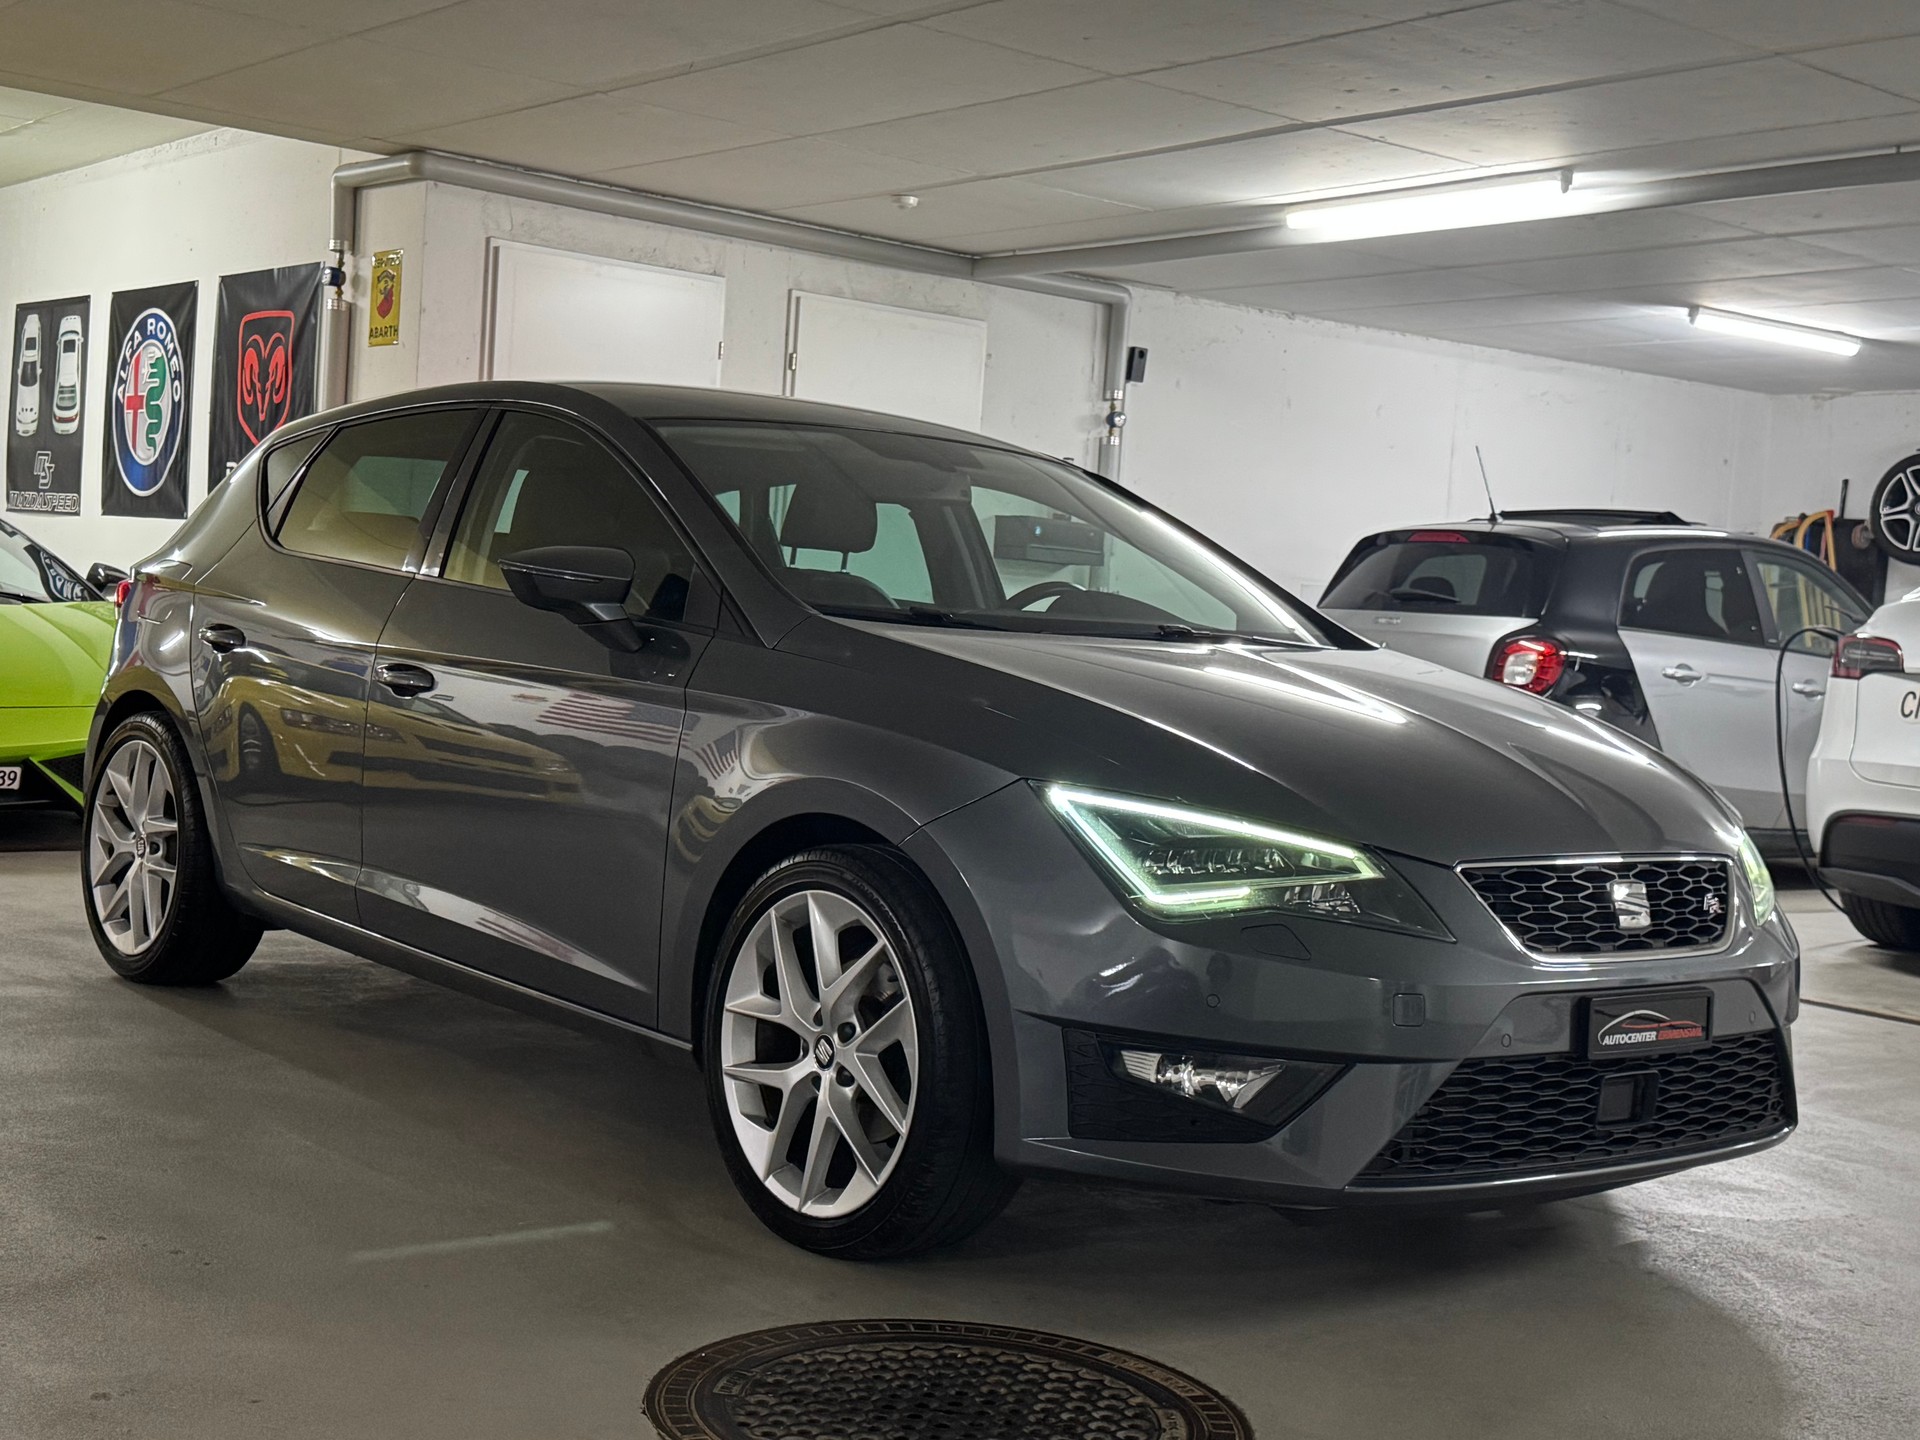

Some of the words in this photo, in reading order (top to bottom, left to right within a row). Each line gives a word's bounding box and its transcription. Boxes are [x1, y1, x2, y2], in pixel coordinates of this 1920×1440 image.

[369, 325, 399, 339] ABARTH
[117, 330, 143, 404] ALFA
[146, 318, 182, 402] ROMEO
[1602, 1031, 1657, 1046] AUTOCENTER
